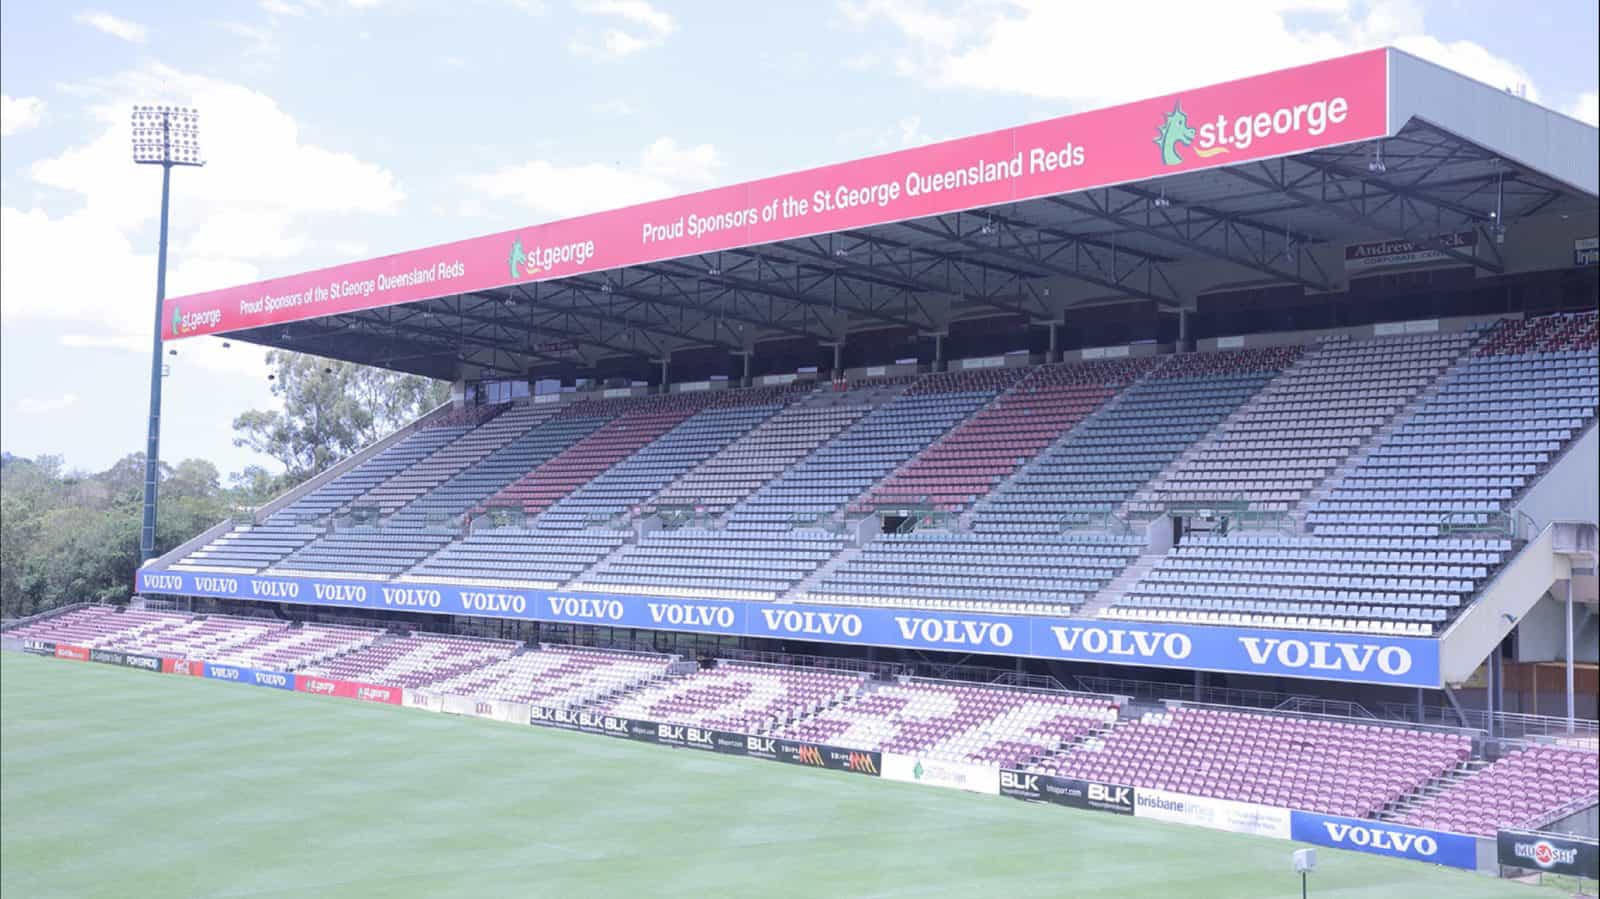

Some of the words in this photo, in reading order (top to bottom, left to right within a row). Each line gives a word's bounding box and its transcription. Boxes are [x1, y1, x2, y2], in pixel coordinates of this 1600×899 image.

[1199, 97, 1348, 148] st.george
[642, 220, 684, 244] Proud
[687, 206, 758, 239] Sponsors
[762, 201, 780, 222] of
[782, 195, 809, 218] the
[813, 181, 901, 213] St.George
[905, 152, 1023, 197] Queensland
[1030, 143, 1085, 174] Reds
[526, 238, 594, 271] st.george
[1355, 239, 1417, 257] Andrew
[240, 296, 263, 315] Proud
[264, 290, 303, 313] Sponsors
[303, 288, 313, 303] of
[314, 286, 328, 301] the
[330, 278, 375, 301] St.George
[378, 268, 436, 292] Queensland
[438, 261, 465, 280] Reds
[181, 306, 221, 330] st.george
[143, 575, 182, 590] VOLVO
[194, 577, 238, 593] VOLVO
[252, 580, 299, 598] VOLVO
[314, 583, 367, 602] VOLVO
[382, 587, 441, 608] VOLVO
[459, 592, 526, 613] VOLVO
[548, 596, 624, 620] VOLVO
[648, 603, 735, 627] VOLVO
[761, 608, 862, 637] VOLVO
[894, 616, 1013, 647] VOLVO
[1051, 626, 1192, 659] VOLVO
[1239, 637, 1412, 676] VOLVO
[210, 666, 239, 680] VOLVO
[255, 672, 286, 686] VOLVO
[531, 707, 554, 720] BLK
[555, 709, 579, 724] BLK
[579, 713, 604, 728] BLK
[605, 716, 629, 733] BLK
[658, 724, 684, 741] BLK
[687, 729, 714, 745] BLK
[747, 737, 776, 753] BLK
[1000, 771, 1040, 791] BLK
[1087, 783, 1132, 805] BLK
[1323, 821, 1438, 856] VOLVO
